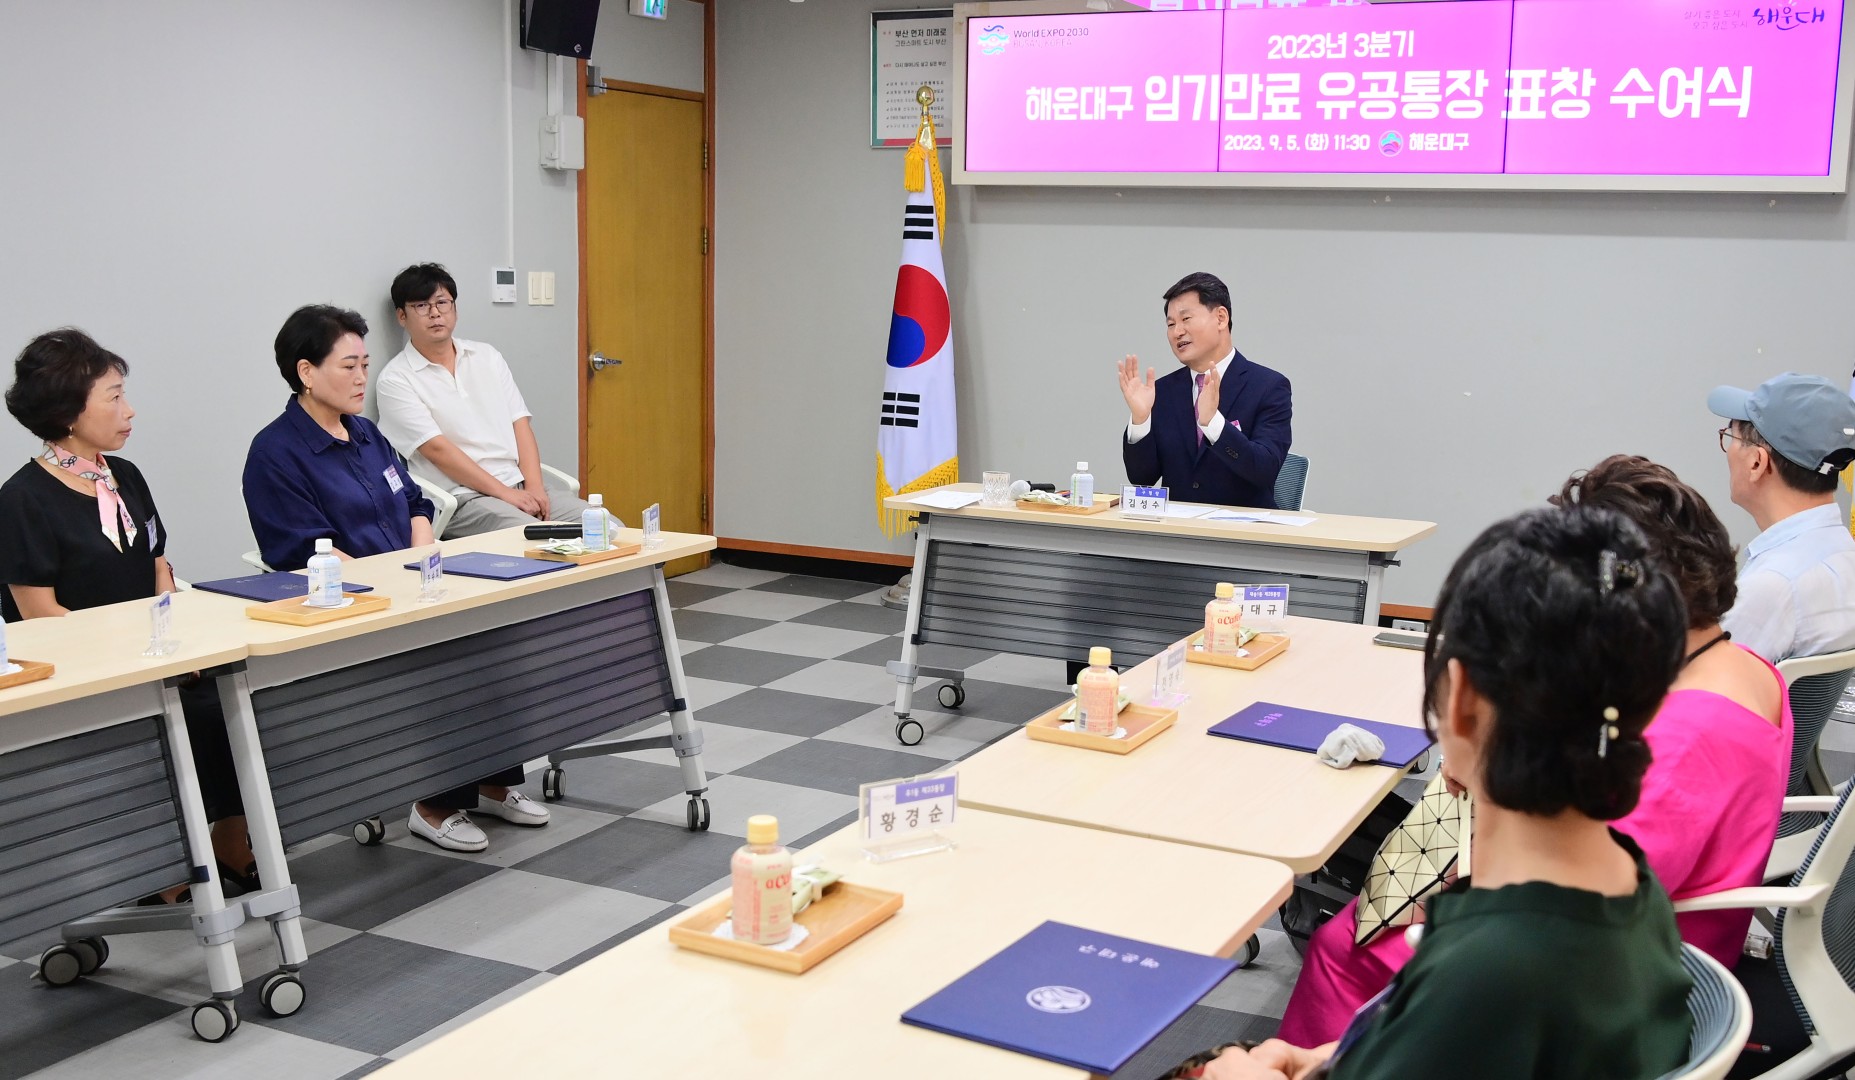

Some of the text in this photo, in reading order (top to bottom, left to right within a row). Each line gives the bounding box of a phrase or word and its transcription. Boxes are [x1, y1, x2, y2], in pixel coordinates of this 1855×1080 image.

[1752, 6, 1825, 31] 해운대
[895, 29, 909, 38] 부산
[911, 29, 924, 38] 먼저
[926, 28, 947, 37] 미래로
[1013, 28, 1089, 38] World EXPO 2030
[1267, 30, 1414, 59] 2023년 3분기
[1025, 65, 1753, 122] 해운대구 임기만료 유공통장 표창 수여식
[1224, 133, 1370, 151] 2023. 9. 5. (화) 11:30
[1409, 132, 1470, 151] 해운대구
